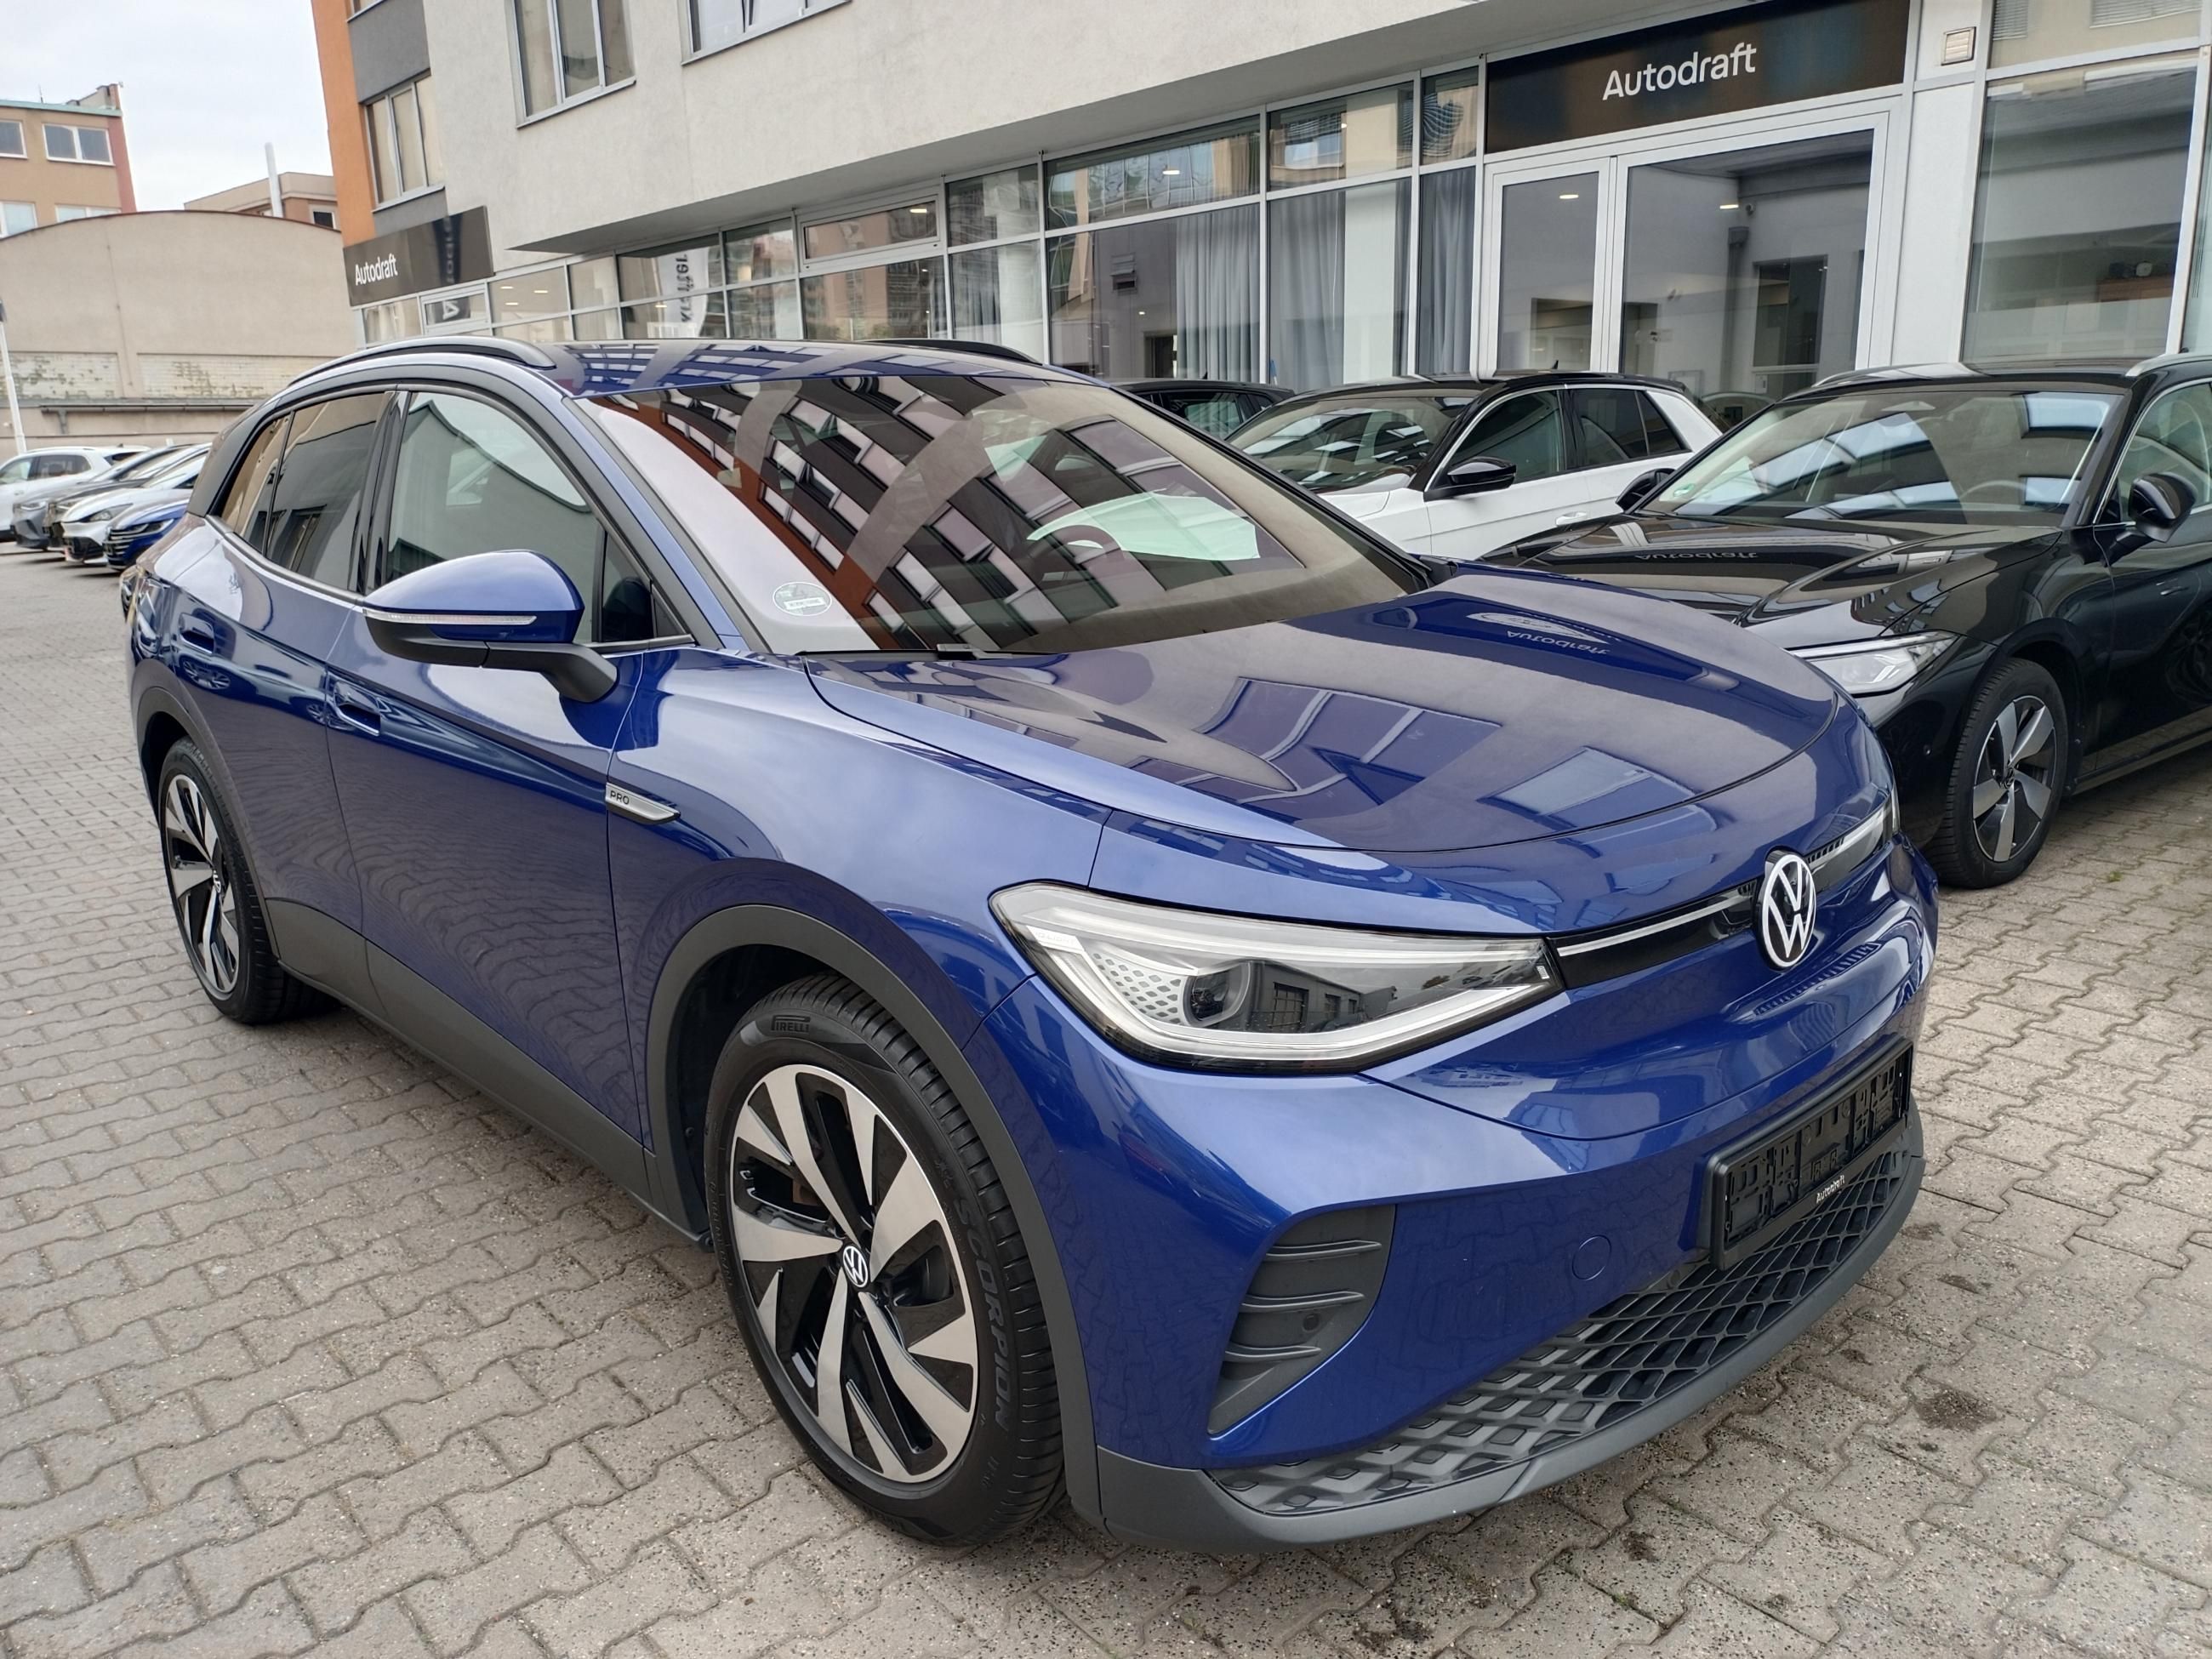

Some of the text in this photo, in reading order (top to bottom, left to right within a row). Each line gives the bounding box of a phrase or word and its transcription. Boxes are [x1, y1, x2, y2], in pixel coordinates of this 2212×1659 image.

[1602, 42, 1757, 100] Autodraft
[355, 253, 398, 286] Autodraft
[610, 790, 630, 805] PRO
[1762, 854, 1816, 967] VW
[771, 1015, 811, 1032] PIRELLI
[843, 1246, 868, 1287] VW
[953, 1198, 1012, 1431] SCORPION
